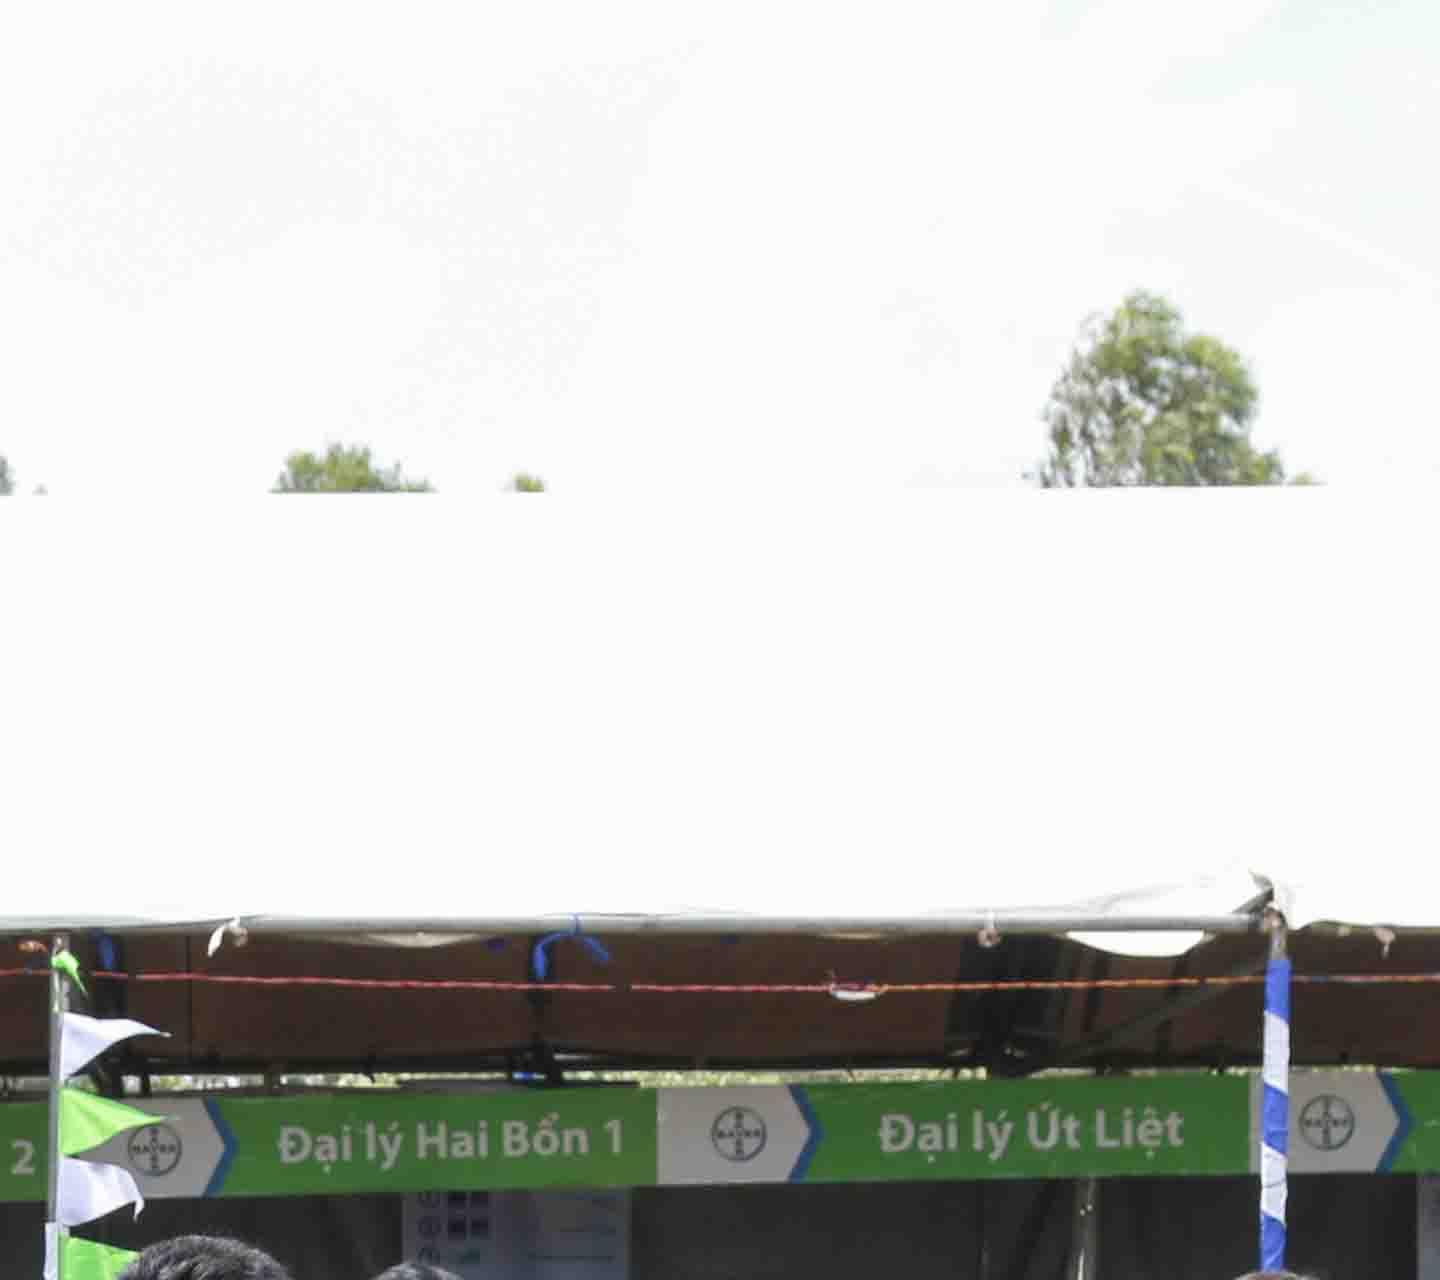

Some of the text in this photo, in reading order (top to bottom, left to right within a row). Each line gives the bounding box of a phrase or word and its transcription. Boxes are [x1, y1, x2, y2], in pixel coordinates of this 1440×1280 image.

[12, 1140, 34, 1174] 2
[278, 1126, 352, 1172] Đại
[365, 1122, 402, 1169] lý
[417, 1120, 488, 1158] Hai
[605, 1120, 621, 1153] 1
[879, 1114, 957, 1162] Đại
[973, 1111, 1013, 1160] lý
[1096, 1107, 1184, 1156] Liệt
